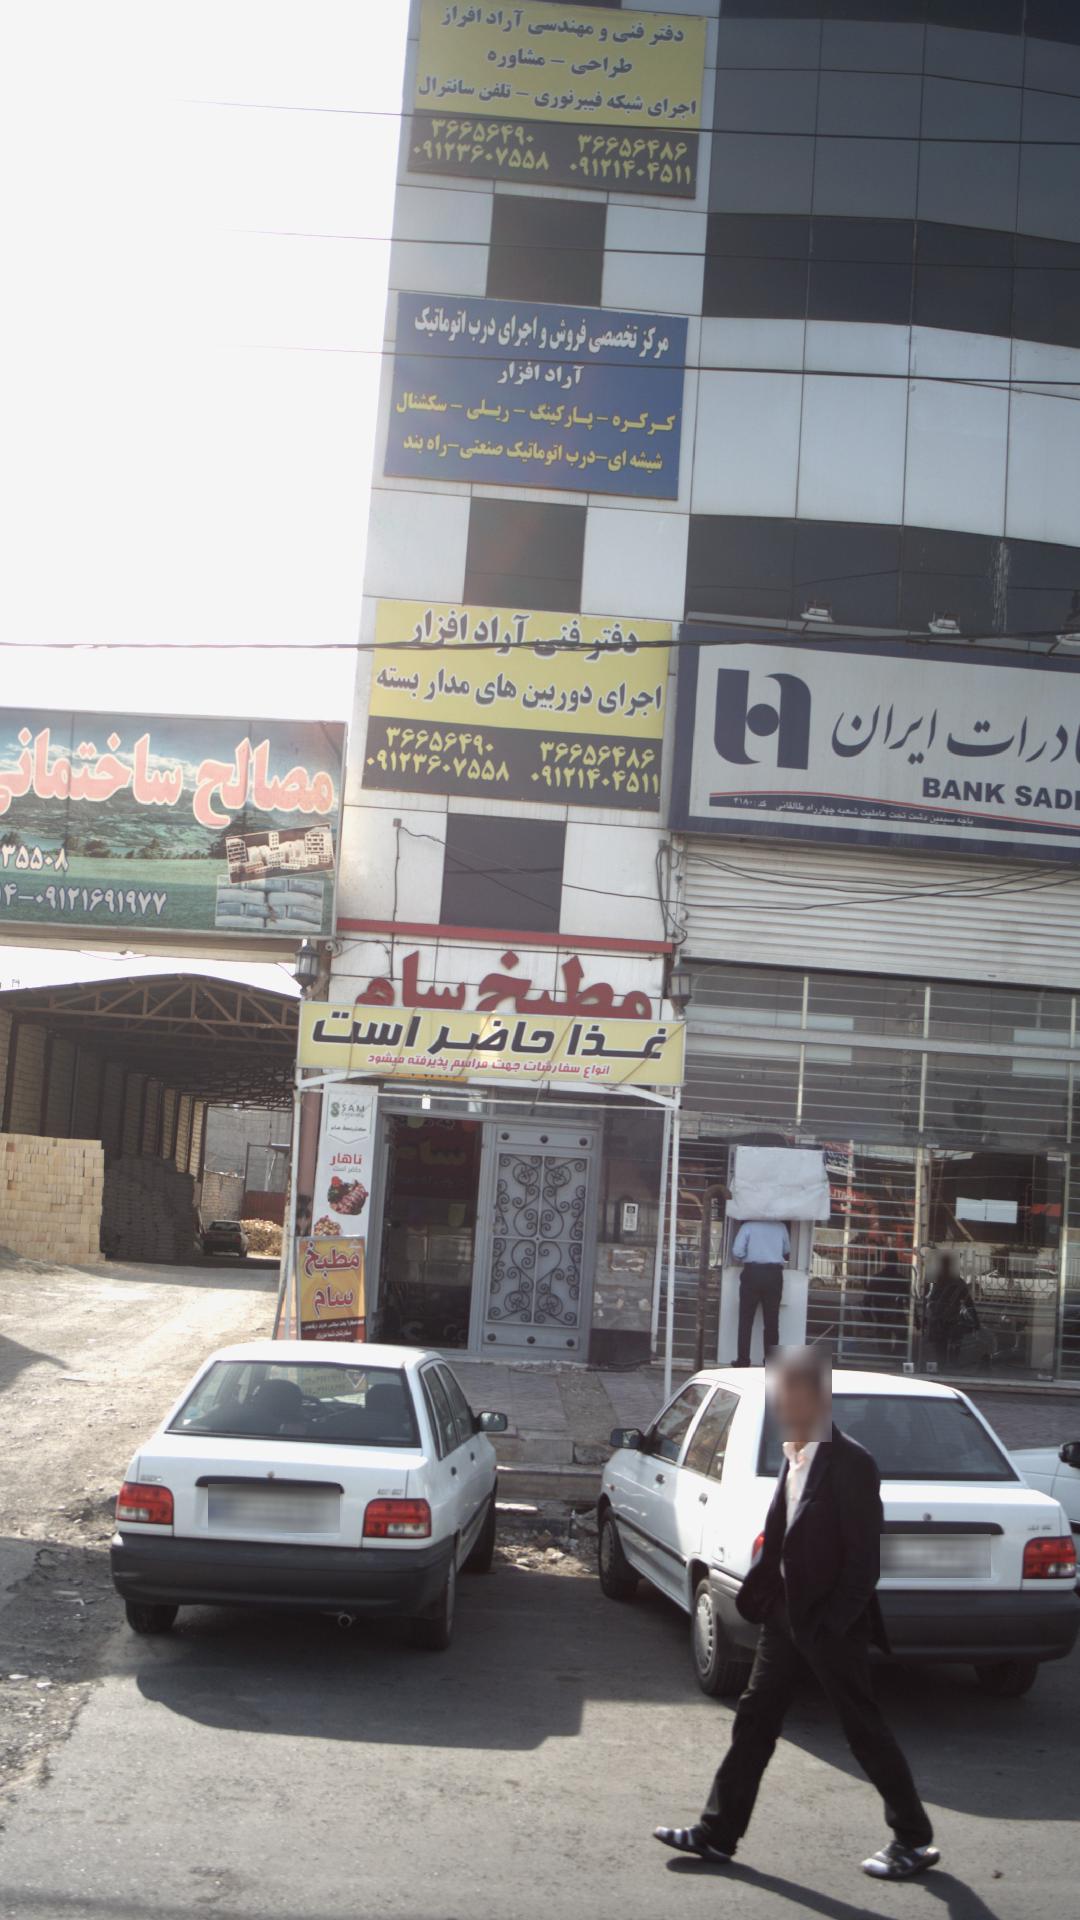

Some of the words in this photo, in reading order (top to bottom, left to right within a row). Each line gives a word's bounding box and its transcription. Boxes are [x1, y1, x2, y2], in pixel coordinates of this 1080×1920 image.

[486, 9, 524, 32] آراد
[528, 19, 594, 38] مهندسی
[613, 24, 644, 43] فنی
[599, 29, 607, 42] و
[649, 24, 684, 45] دفتر
[487, 48, 545, 69] مشاوره
[571, 54, 633, 78] طراحی
[418, 76, 475, 96] سانترال
[478, 83, 511, 102] تلفن
[606, 92, 643, 111] شبکه
[649, 98, 697, 119] اجرای
[432, 118, 533, 145] ۳۶۶۵۶۴۹۰
[412, 140, 550, 170] ۰۹۱۲۳۶۰۷۵۵۸
[577, 133, 687, 161] ۳۶۶۵۶۴۸۶
[569, 155, 692, 185] ۰۹۱۲۱۴۰۴۵۱۱
[414, 306, 465, 341] اتوماتیک
[468, 317, 495, 344] درب
[498, 316, 537, 347] اجرای
[550, 318, 587, 352] فروش
[540, 329, 546, 348] و
[589, 325, 637, 353] تخصصی
[639, 327, 669, 359] مرکز
[497, 361, 540, 385] افزار
[545, 364, 584, 389] آراد
[396, 392, 448, 414] سکشنال
[466, 399, 510, 422] ریلی
[530, 403, 593, 430] پارکینگ
[612, 413, 676, 435] کرکره
[403, 435, 423, 450] بند
[507, 442, 562, 466] اتوماتیک
[630, 451, 663, 474] شیشه
[410, 608, 468, 648] افزار
[474, 614, 530, 654] آراد
[534, 619, 580, 657] فنی
[585, 622, 638, 661] دفتر
[376, 666, 420, 697] بسته
[424, 668, 469, 700] مدار
[475, 673, 517, 706] های
[522, 684, 593, 713] دوربین
[597, 682, 662, 716] اجرای
[386, 726, 494, 755] ۳۶۶۵۶۴۹۰
[831, 703, 938, 765] ایران
[366, 748, 510, 781] ۰۹۱۲۳۶۰۷۵۵۸
[540, 740, 655, 768] ۳۶۶۵۶۴۸۶
[193, 737, 335, 829] مصالح
[530, 766, 660, 795] ۰۹۱۲۱۴۰۴۵۱۱
[922, 776, 1006, 807] BANK
[775, 801, 805, 812] طالقانی
[356, 950, 466, 1009] سام
[312, 1011, 422, 1047] است
[427, 1021, 555, 1055] حاضر
[567, 1023, 667, 1060] غذا
[368, 1052, 404, 1067] میشود
[408, 1055, 449, 1070] پذیرفته
[451, 1058, 488, 1071] مراسم
[492, 1059, 520, 1072] جهت
[523, 1060, 581, 1074] سفارشات
[583, 1065, 610, 1078] انواع
[329, 1152, 362, 1167] ناهار
[304, 1240, 361, 1278] مطبخ
[313, 1285, 353, 1317] سام
